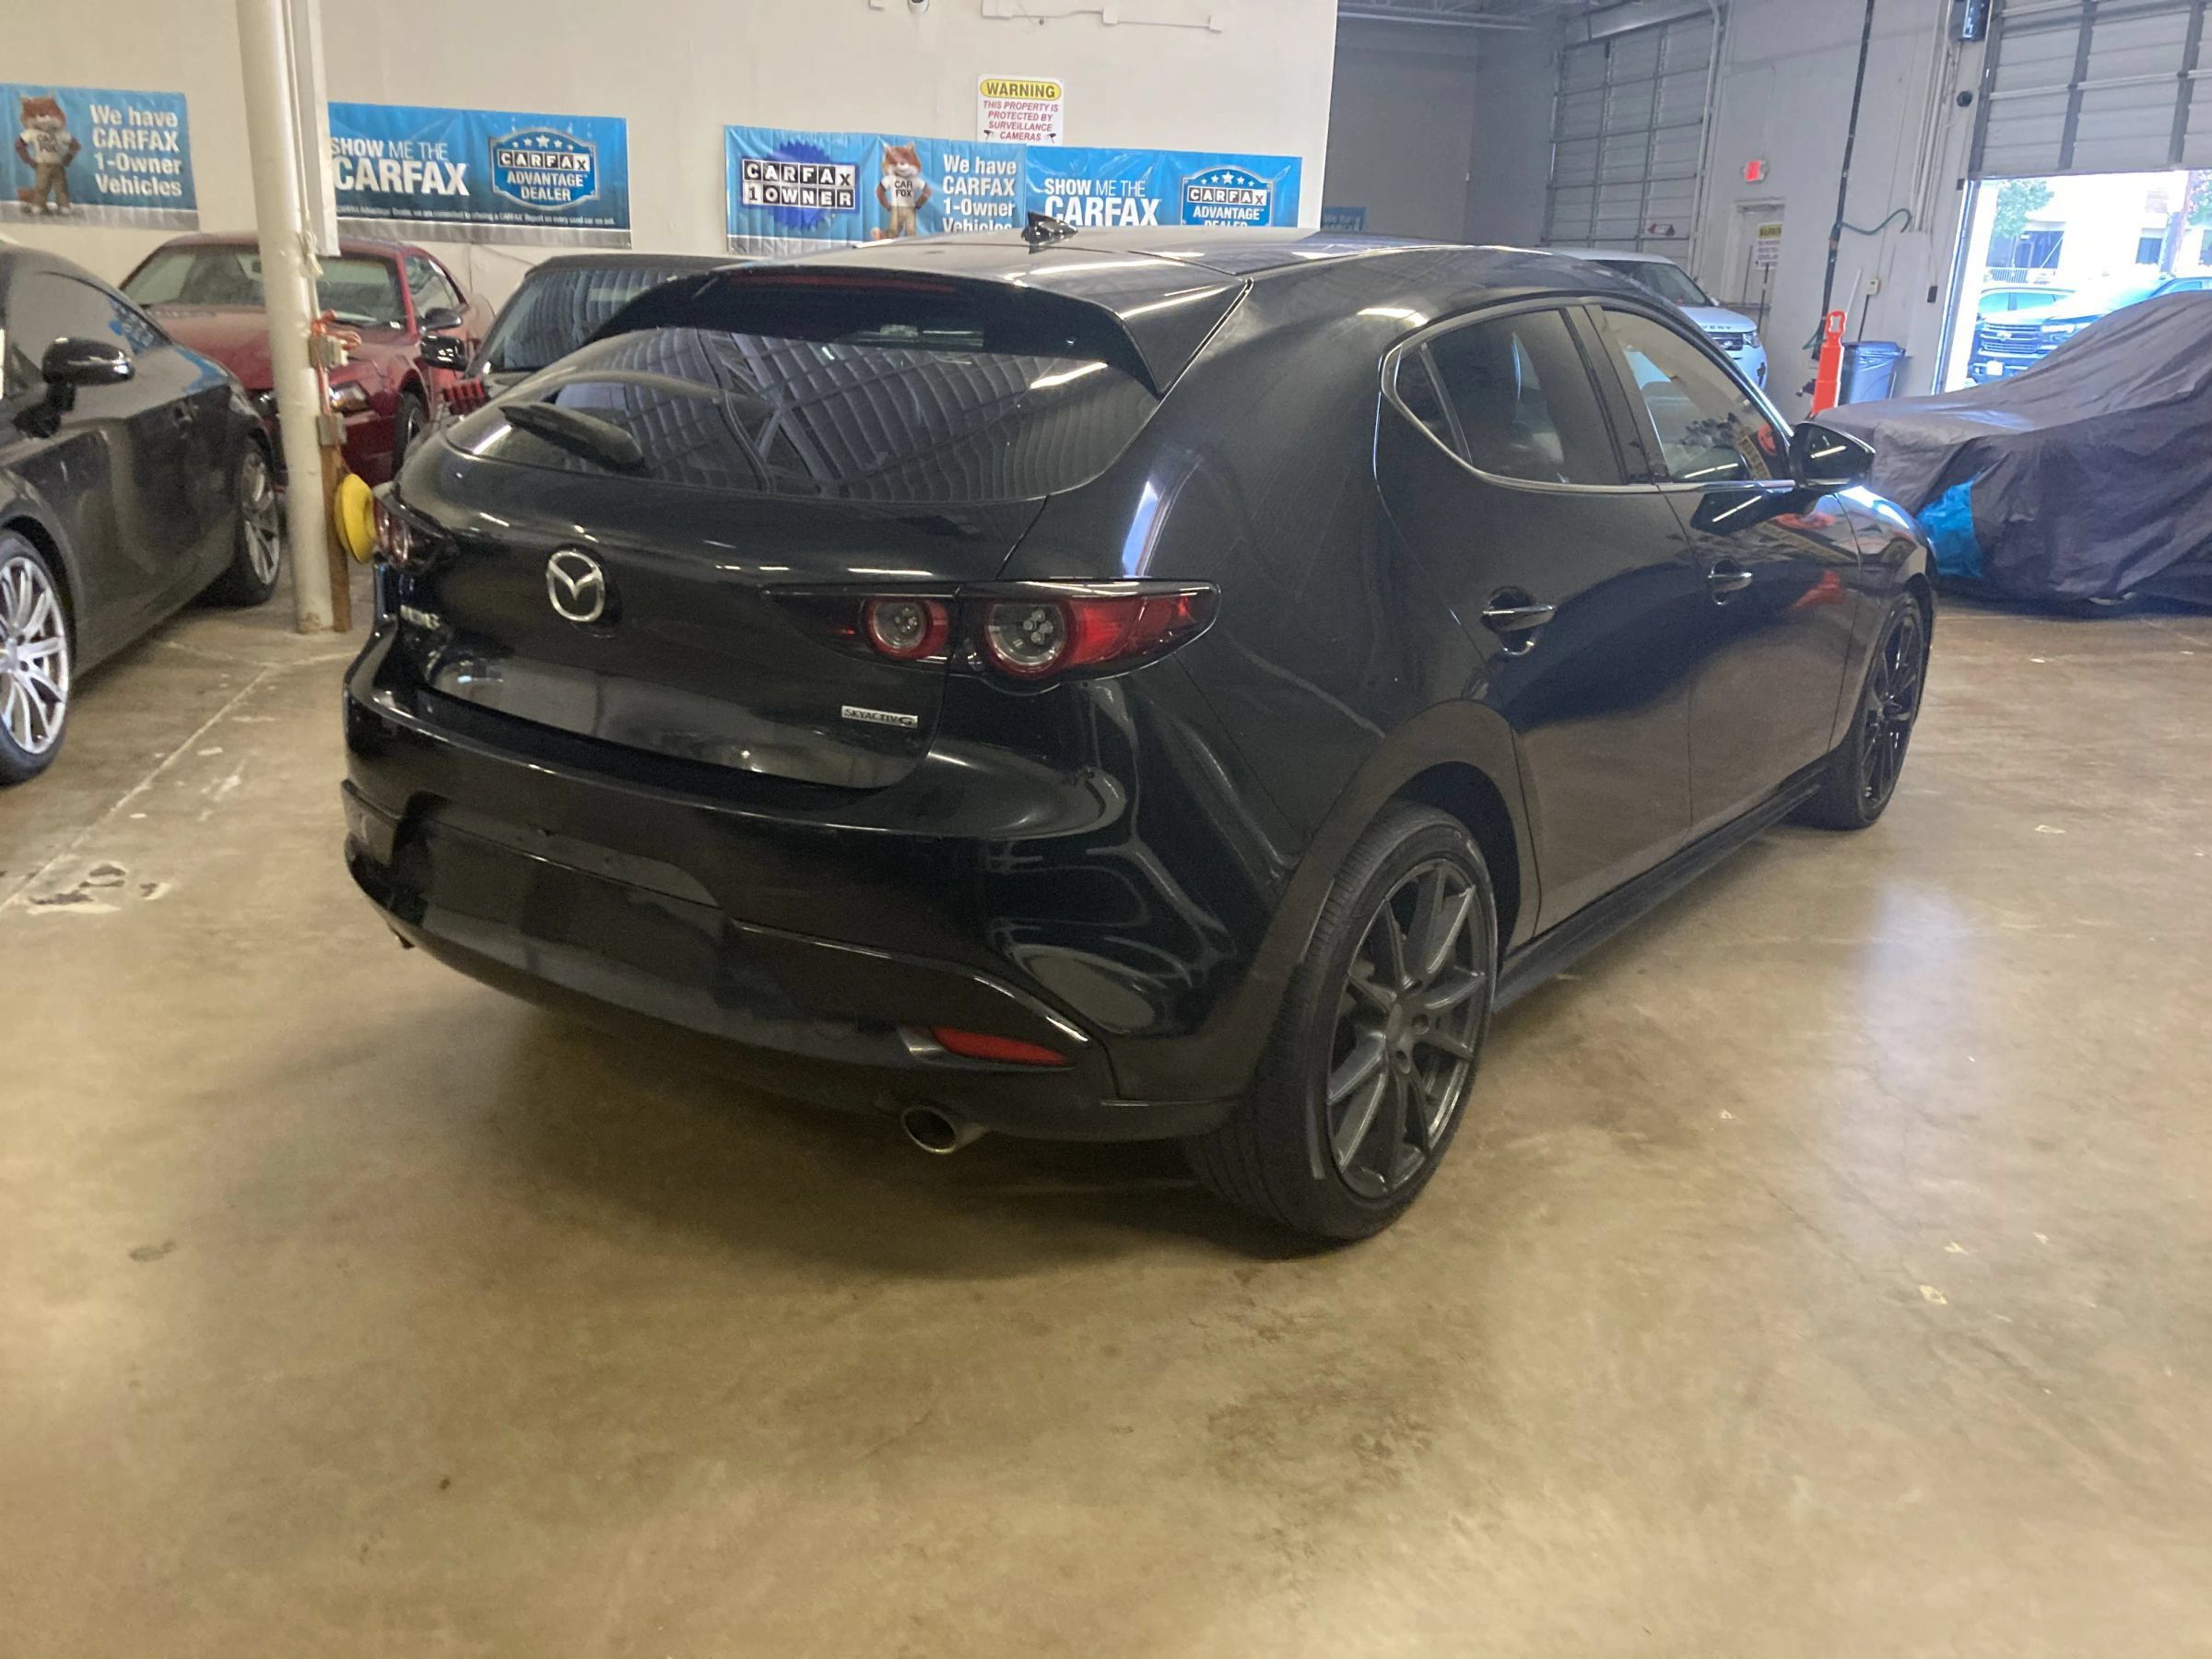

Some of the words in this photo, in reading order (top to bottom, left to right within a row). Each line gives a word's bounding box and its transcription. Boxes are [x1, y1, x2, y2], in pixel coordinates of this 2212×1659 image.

[986, 82, 1055, 98] WARNING
[983, 100, 1002, 109] THIS
[1004, 101, 1050, 111] PROPERTY
[89, 104, 122, 125] We
[128, 106, 178, 127] have
[988, 111, 1039, 121] PROTECTED
[1041, 113, 1053, 122] BY
[988, 121, 1053, 132] SURVEILLANCE
[92, 126, 181, 152] CARFAX
[999, 132, 1041, 141] CAMERAS
[331, 136, 384, 158] SHOW
[388, 140, 414, 159] ME
[418, 142, 449, 160] THE
[94, 151, 182, 175] 1-Owner
[500, 152, 587, 171] CARFAX
[943, 154, 970, 173] We
[975, 156, 1017, 175] have
[333, 155, 470, 196] CARFAX
[507, 171, 583, 187] ADVANTAGE
[746, 162, 852, 186] CARFAX
[95, 173, 182, 196] Vehicles
[521, 186, 571, 201] DEALER
[894, 180, 913, 189] CAR
[943, 175, 1016, 196] CARFAX
[1044, 178, 1091, 196] SHOW
[1096, 180, 1117, 196] ME
[1121, 181, 1147, 197] THE
[1190, 188, 1264, 205] CARFAX
[943, 197, 1016, 217] 1-Owner
[1044, 195, 1161, 227] CARFAX
[1193, 206, 1260, 220] ADVANTAGE
